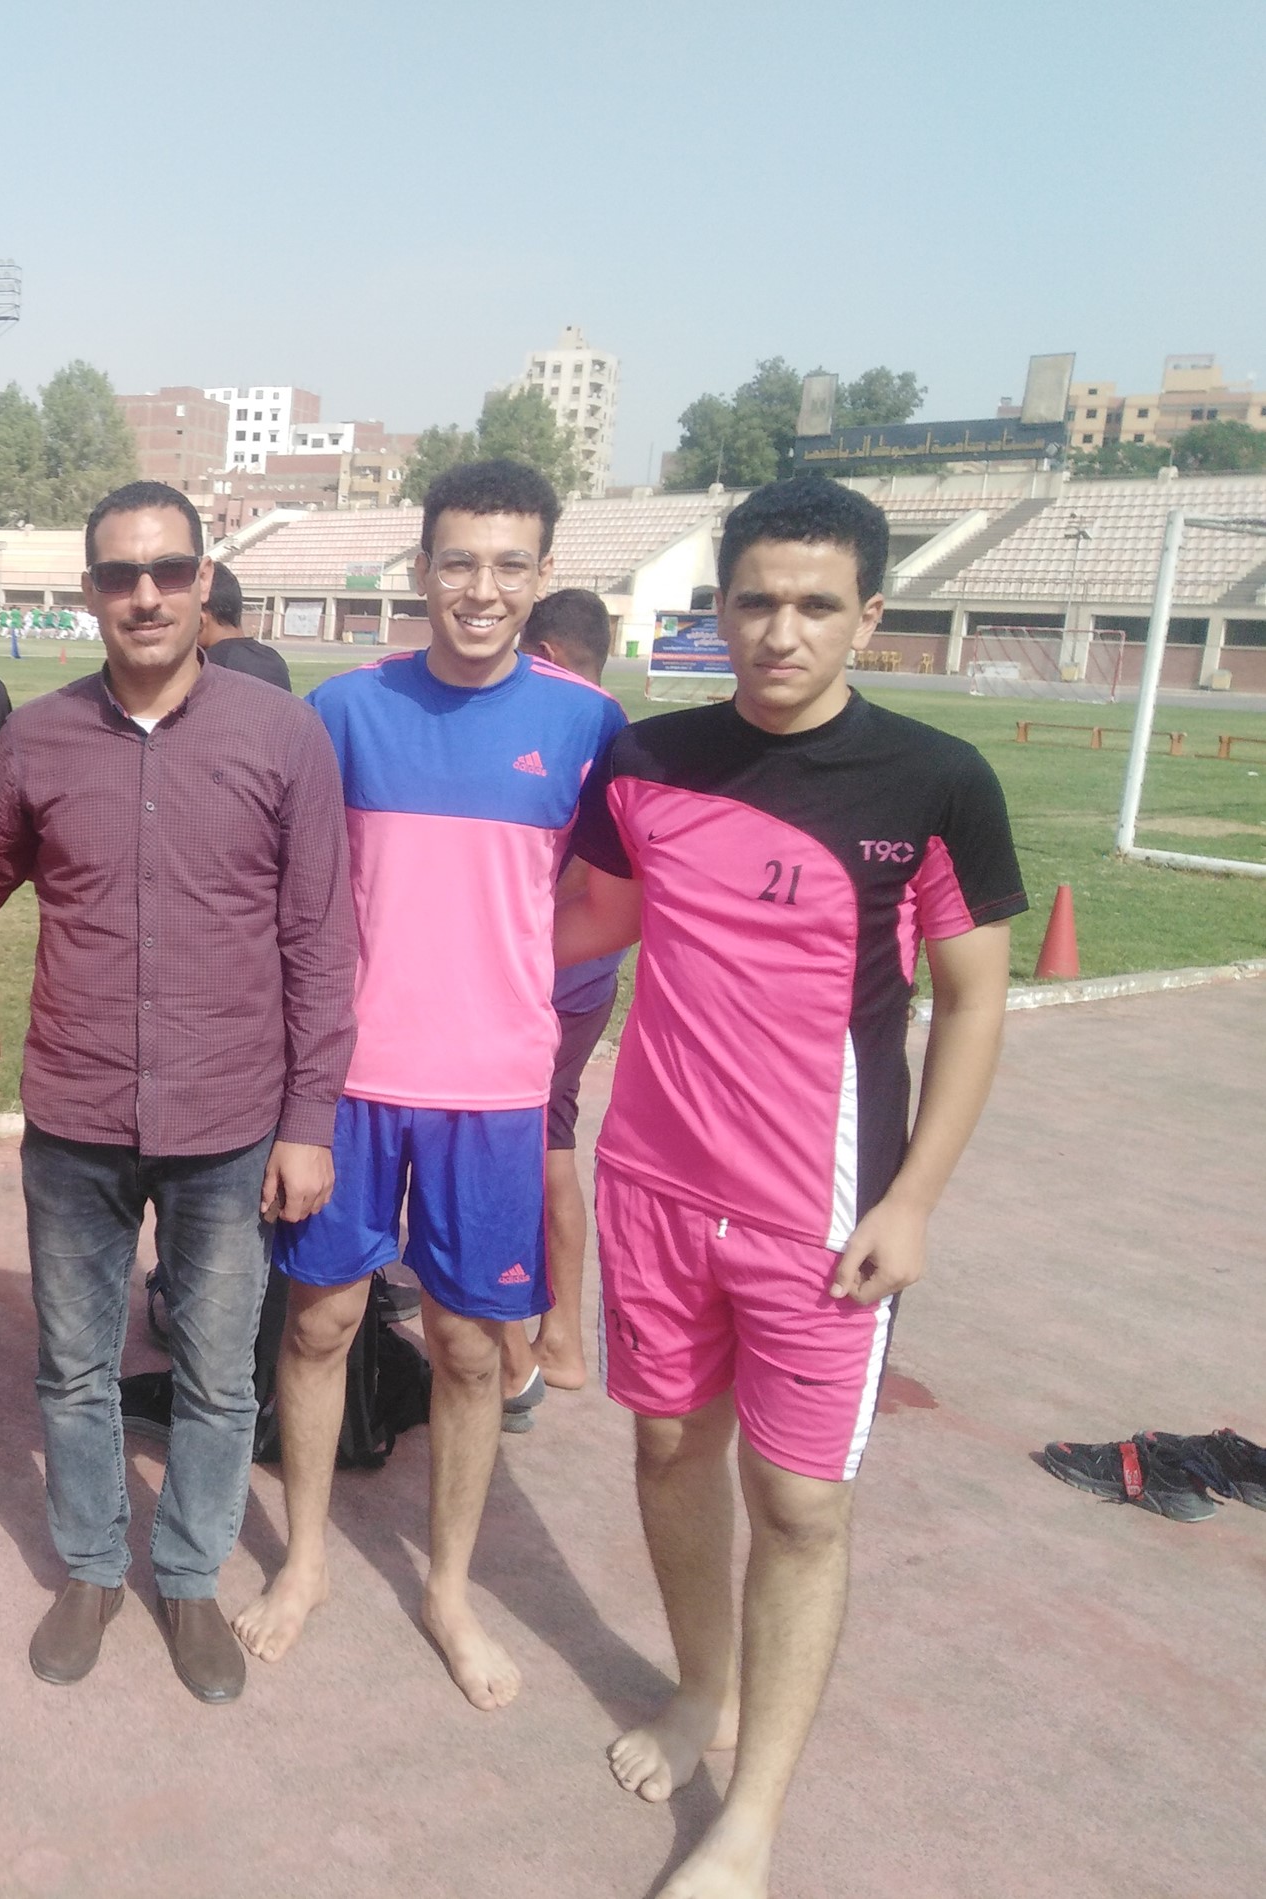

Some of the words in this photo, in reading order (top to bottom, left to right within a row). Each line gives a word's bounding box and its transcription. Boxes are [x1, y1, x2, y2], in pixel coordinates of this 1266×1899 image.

[513, 761, 547, 777] adidas
[859, 840, 915, 863] T90
[757, 860, 803, 905] 21
[498, 1274, 531, 1284] adidas
